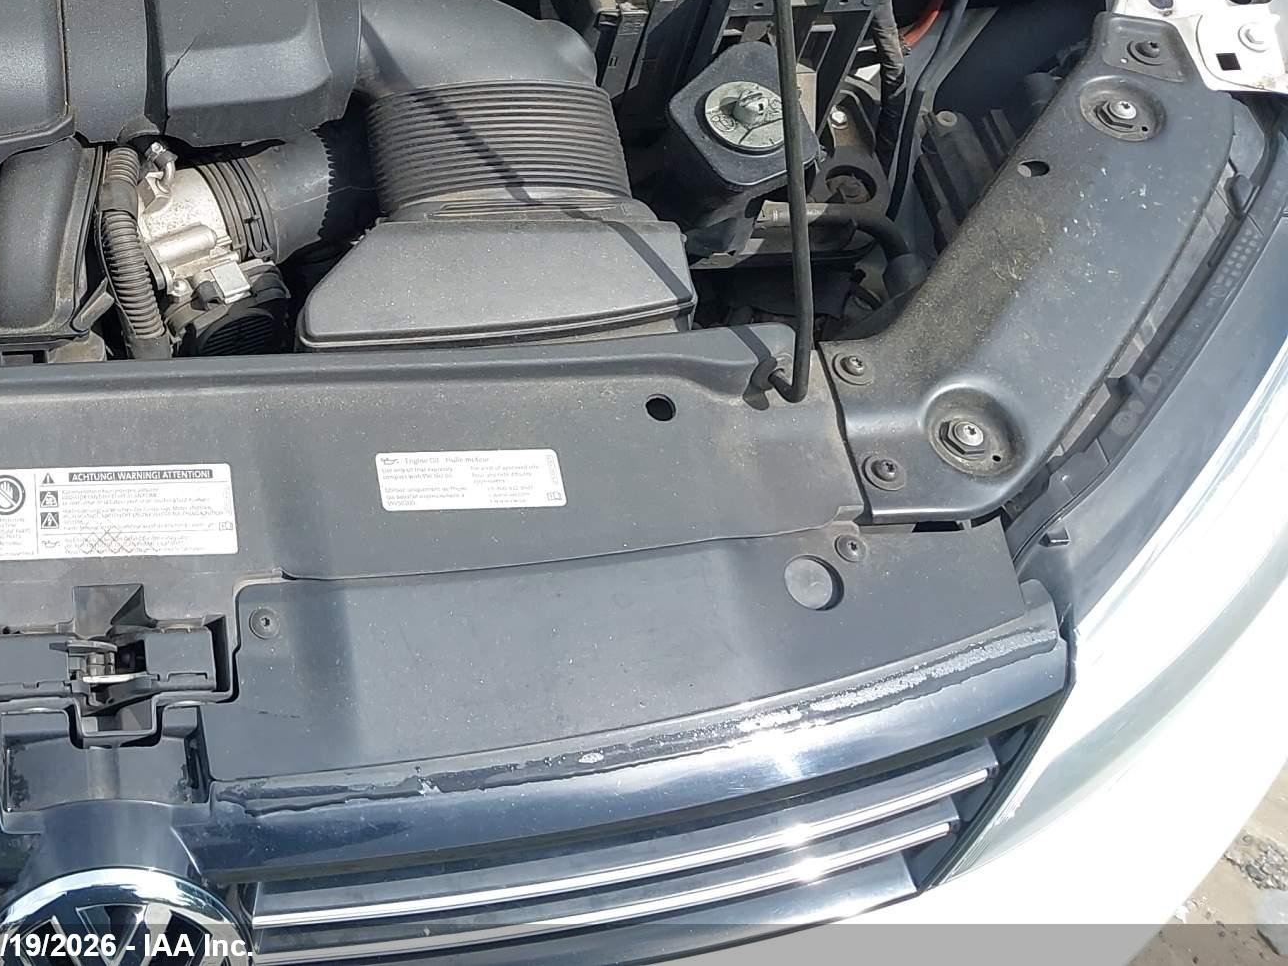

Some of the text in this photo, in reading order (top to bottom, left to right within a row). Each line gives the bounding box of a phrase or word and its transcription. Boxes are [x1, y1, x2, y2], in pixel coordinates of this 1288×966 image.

[72, 469, 211, 482] ACHTUNG! WARNING! ATTENTION!
